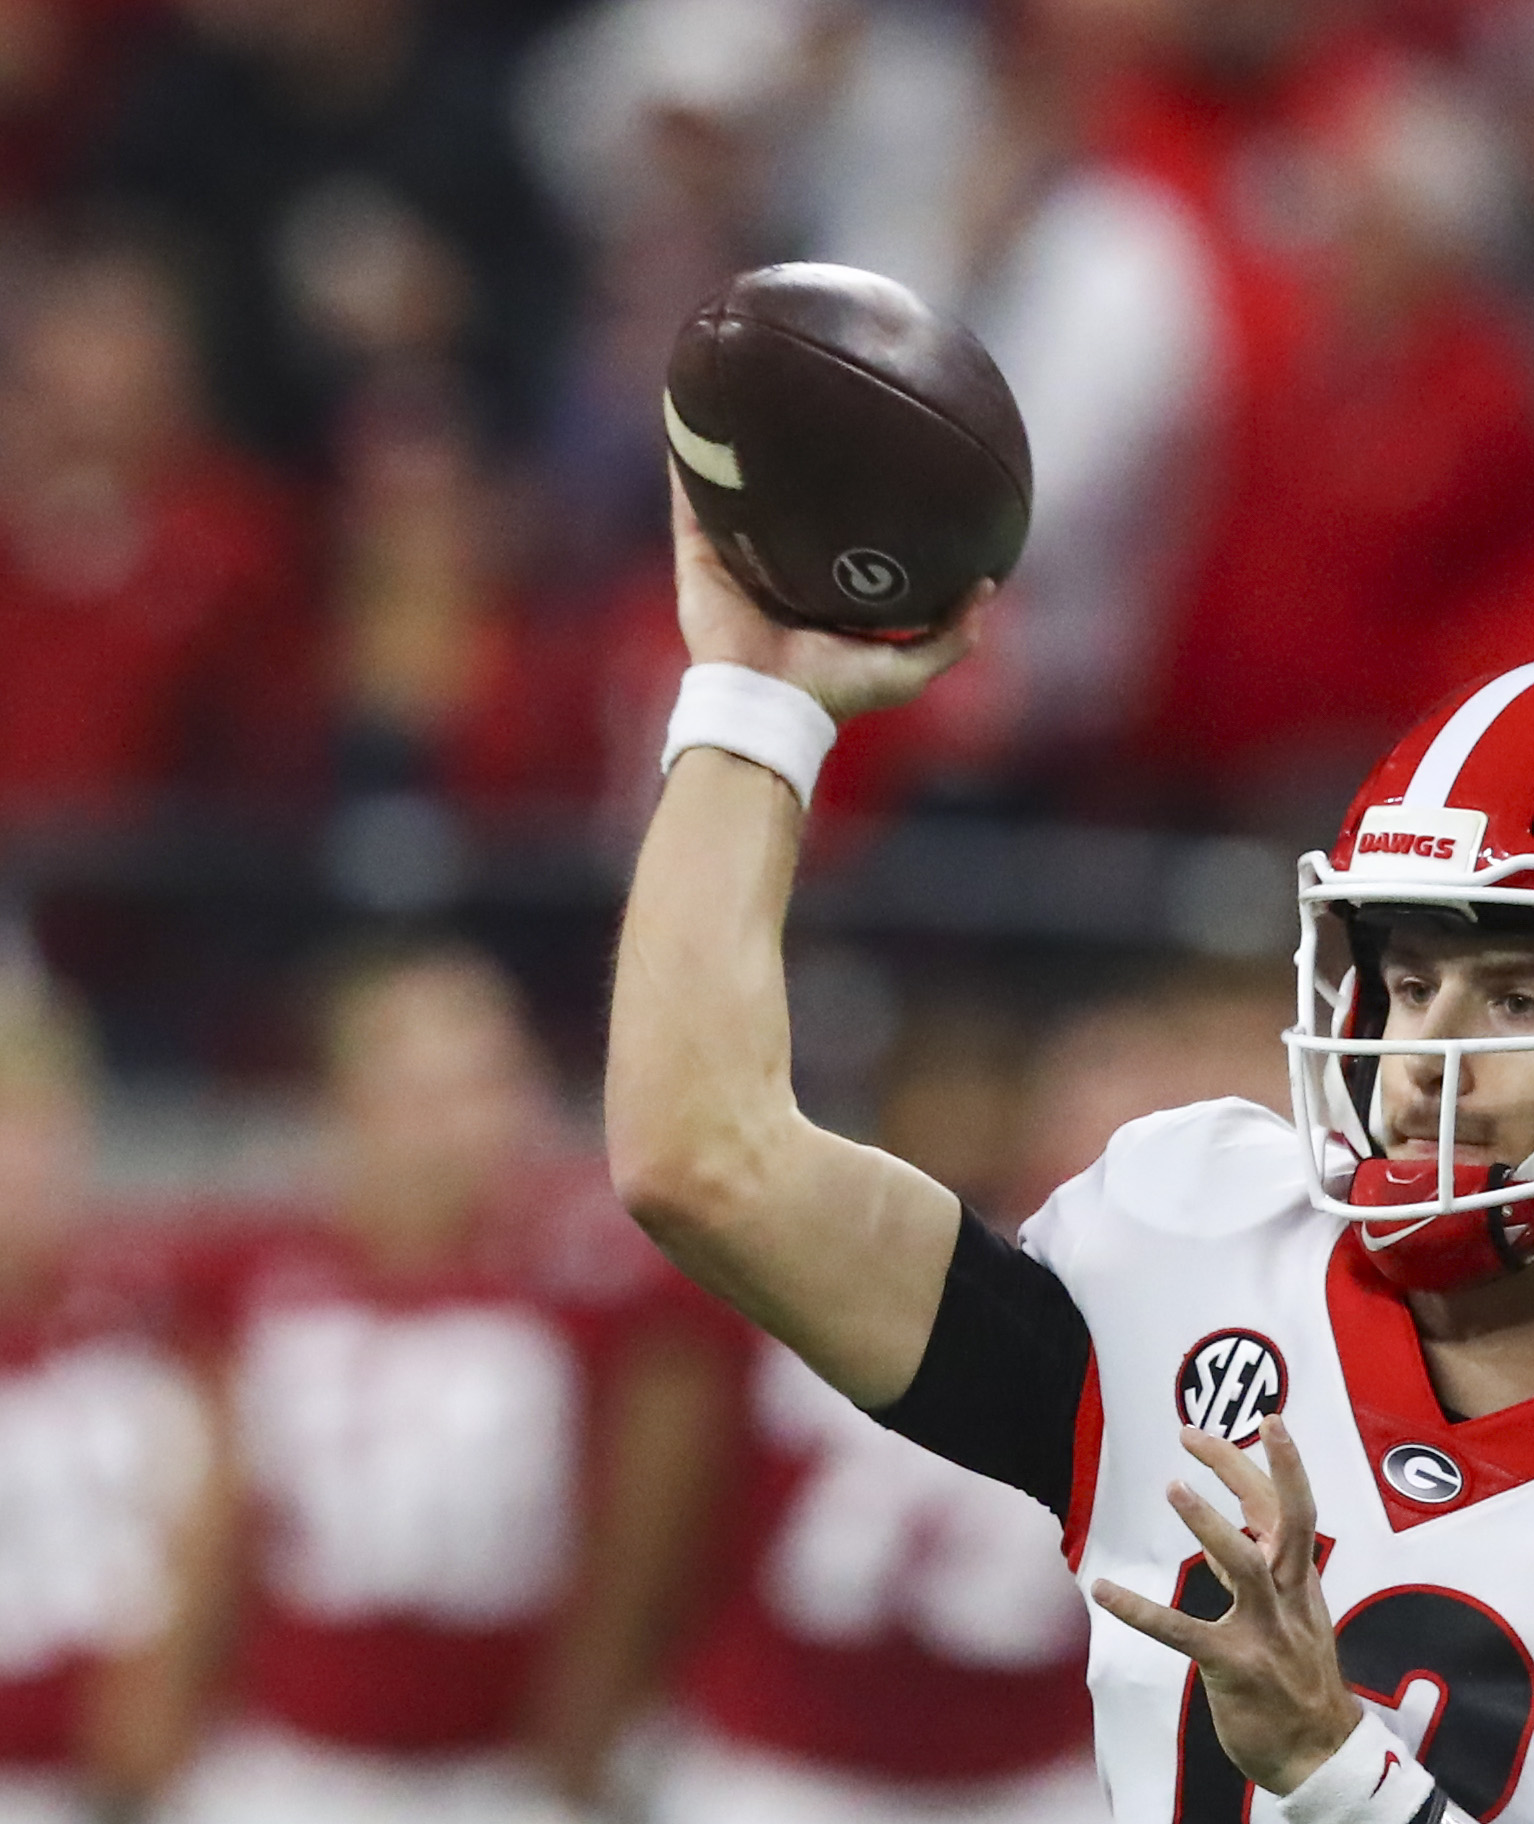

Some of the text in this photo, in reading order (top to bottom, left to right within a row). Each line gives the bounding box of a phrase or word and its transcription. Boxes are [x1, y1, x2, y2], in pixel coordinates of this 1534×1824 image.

[1358, 832, 1457, 860] DAWGS
[1183, 1336, 1279, 1443] SEC
[1382, 1443, 1464, 1503] G
